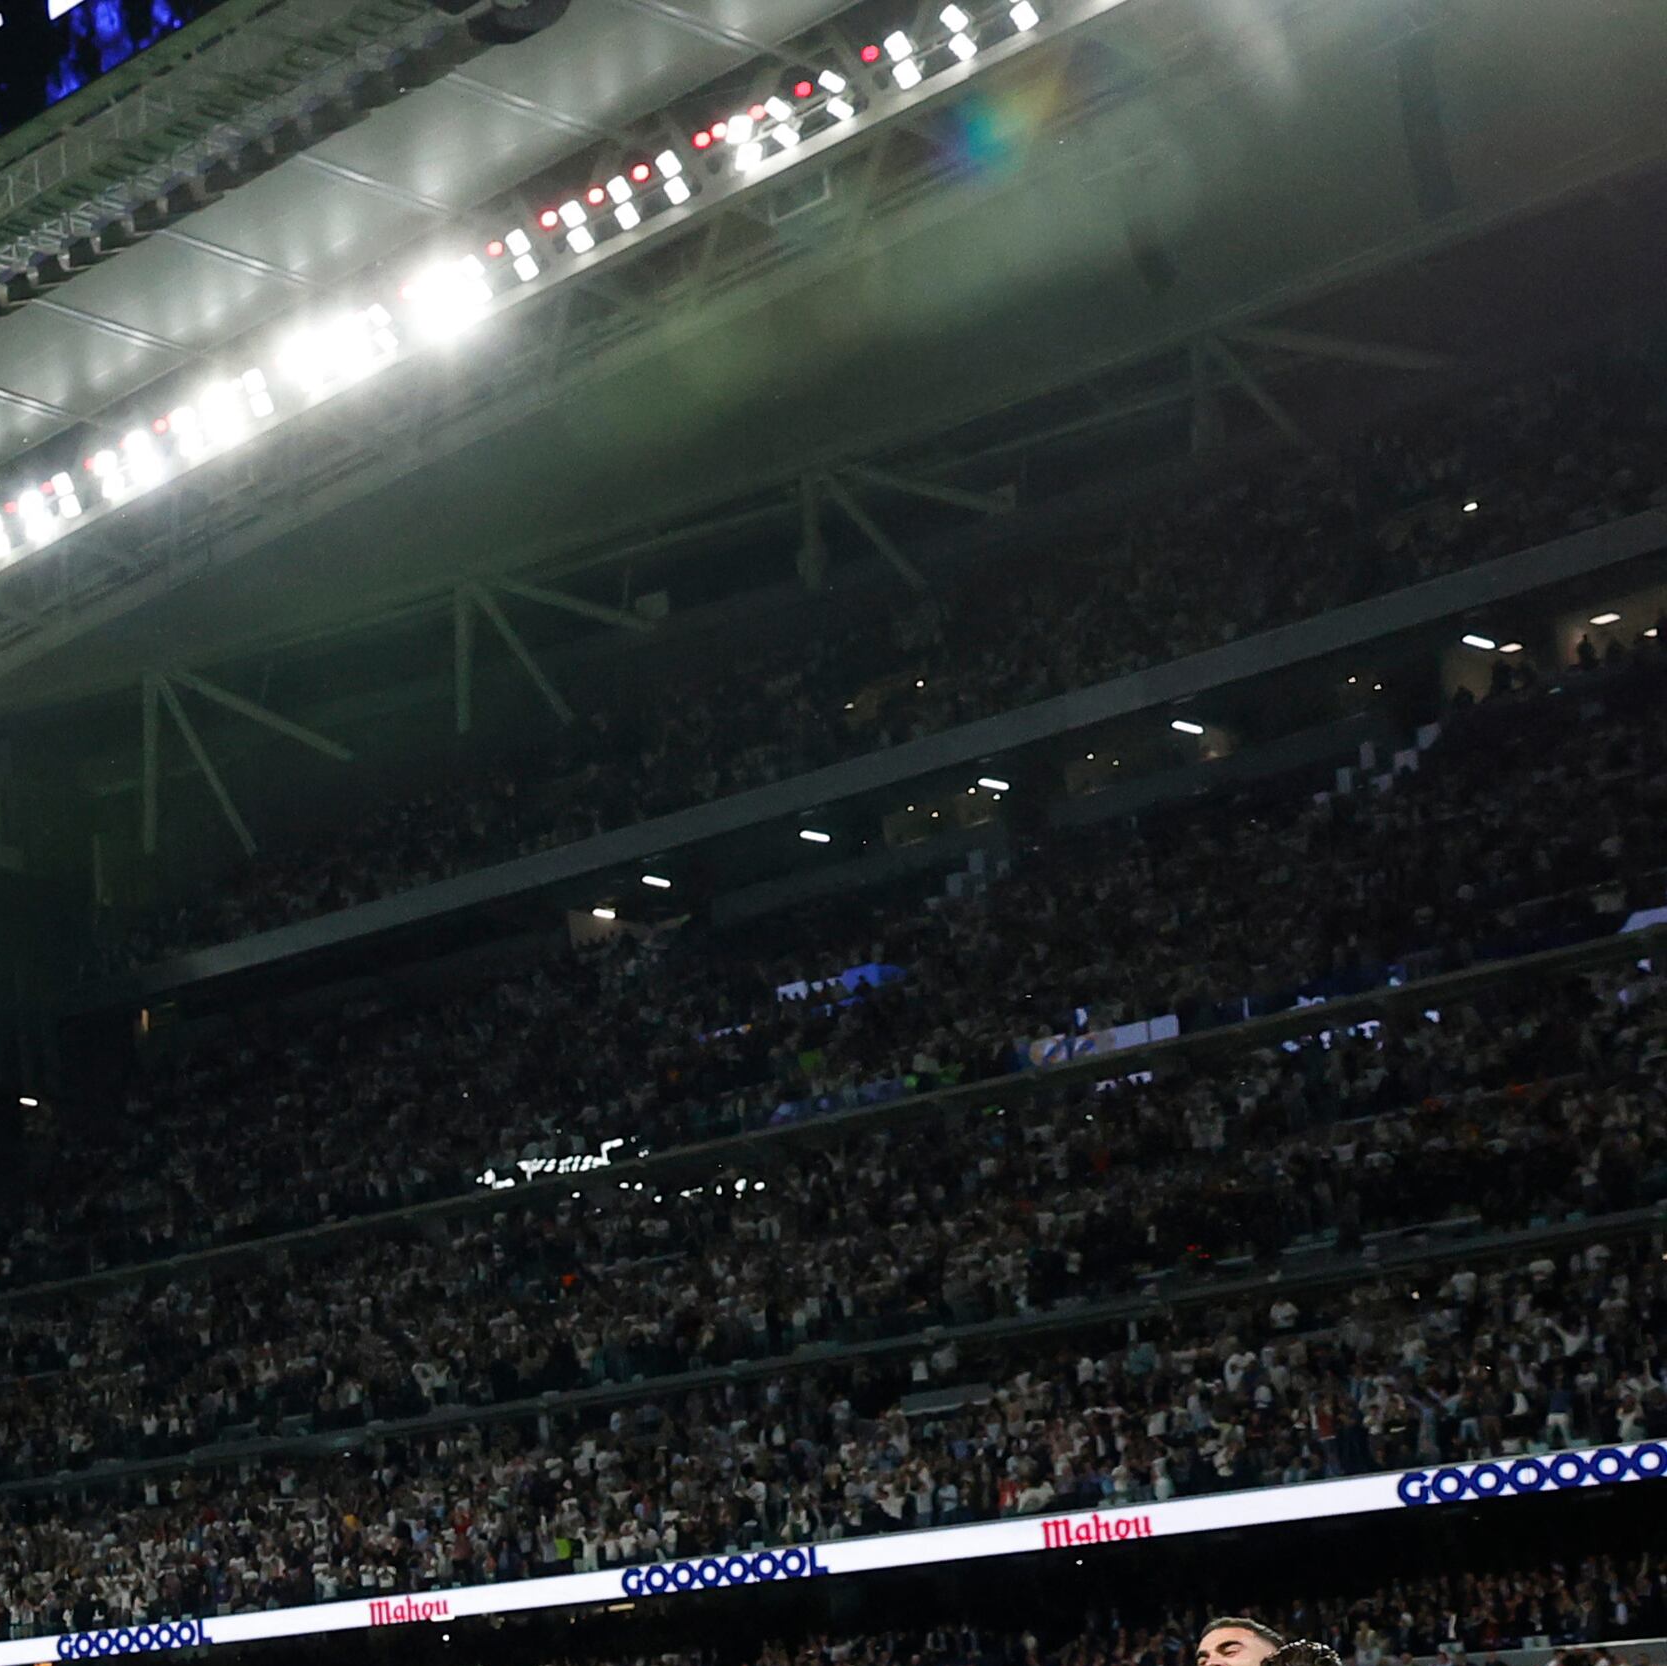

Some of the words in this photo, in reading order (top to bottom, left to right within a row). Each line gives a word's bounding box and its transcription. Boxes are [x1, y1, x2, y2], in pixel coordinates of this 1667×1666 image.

[1397, 1442, 1667, 1507] GOOOOOO
[1042, 1511, 1153, 1548] Mahou
[622, 1546, 829, 1597] GOOOOOOL
[369, 1595, 449, 1626] Mahou
[57, 1618, 213, 1660] GOOOOOOL
